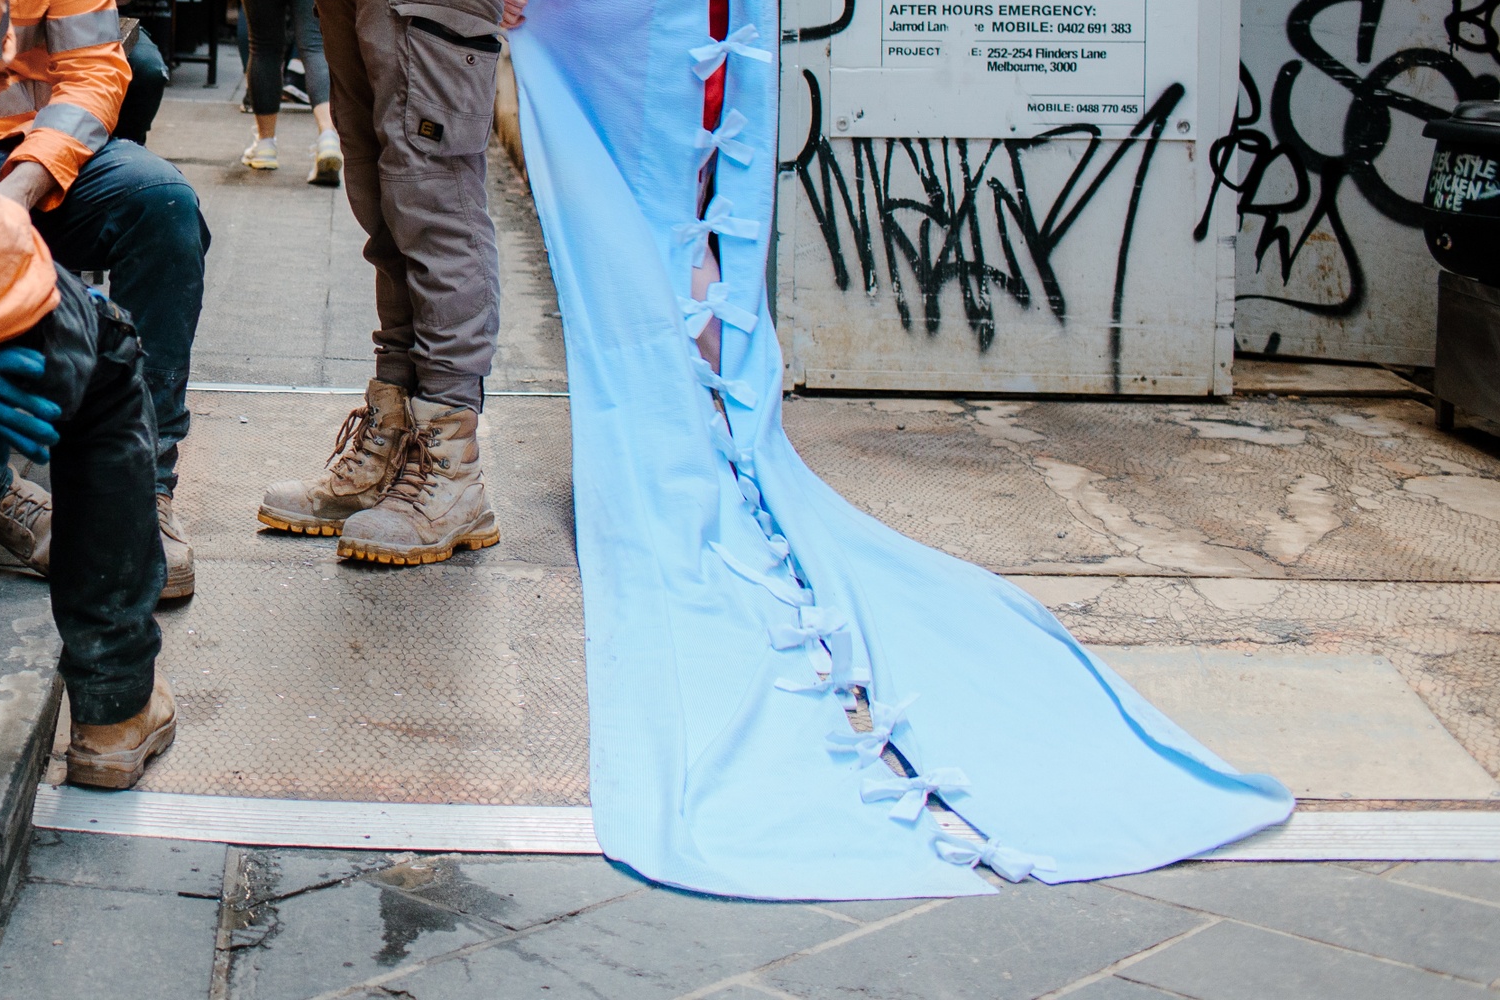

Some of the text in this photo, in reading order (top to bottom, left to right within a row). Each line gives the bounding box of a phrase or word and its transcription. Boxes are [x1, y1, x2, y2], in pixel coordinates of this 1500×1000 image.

[889, 5, 1096, 16] AFTER HOURS EMERGENCY:
[889, 21, 925, 32] Jarrod
[992, 22, 1054, 33] MOBILE:
[1057, 23, 1085, 34] 0402
[1087, 23, 1107, 34] 691
[1111, 23, 1132, 34] 383
[888, 47, 1107, 60] PROJECT 252-254 Flinders Lane
[987, 62, 1077, 74] Melbourne, 3000
[1027, 104, 1139, 114] MOBILE: 0488 770 455
[1454, 153, 1499, 180] STYLE
